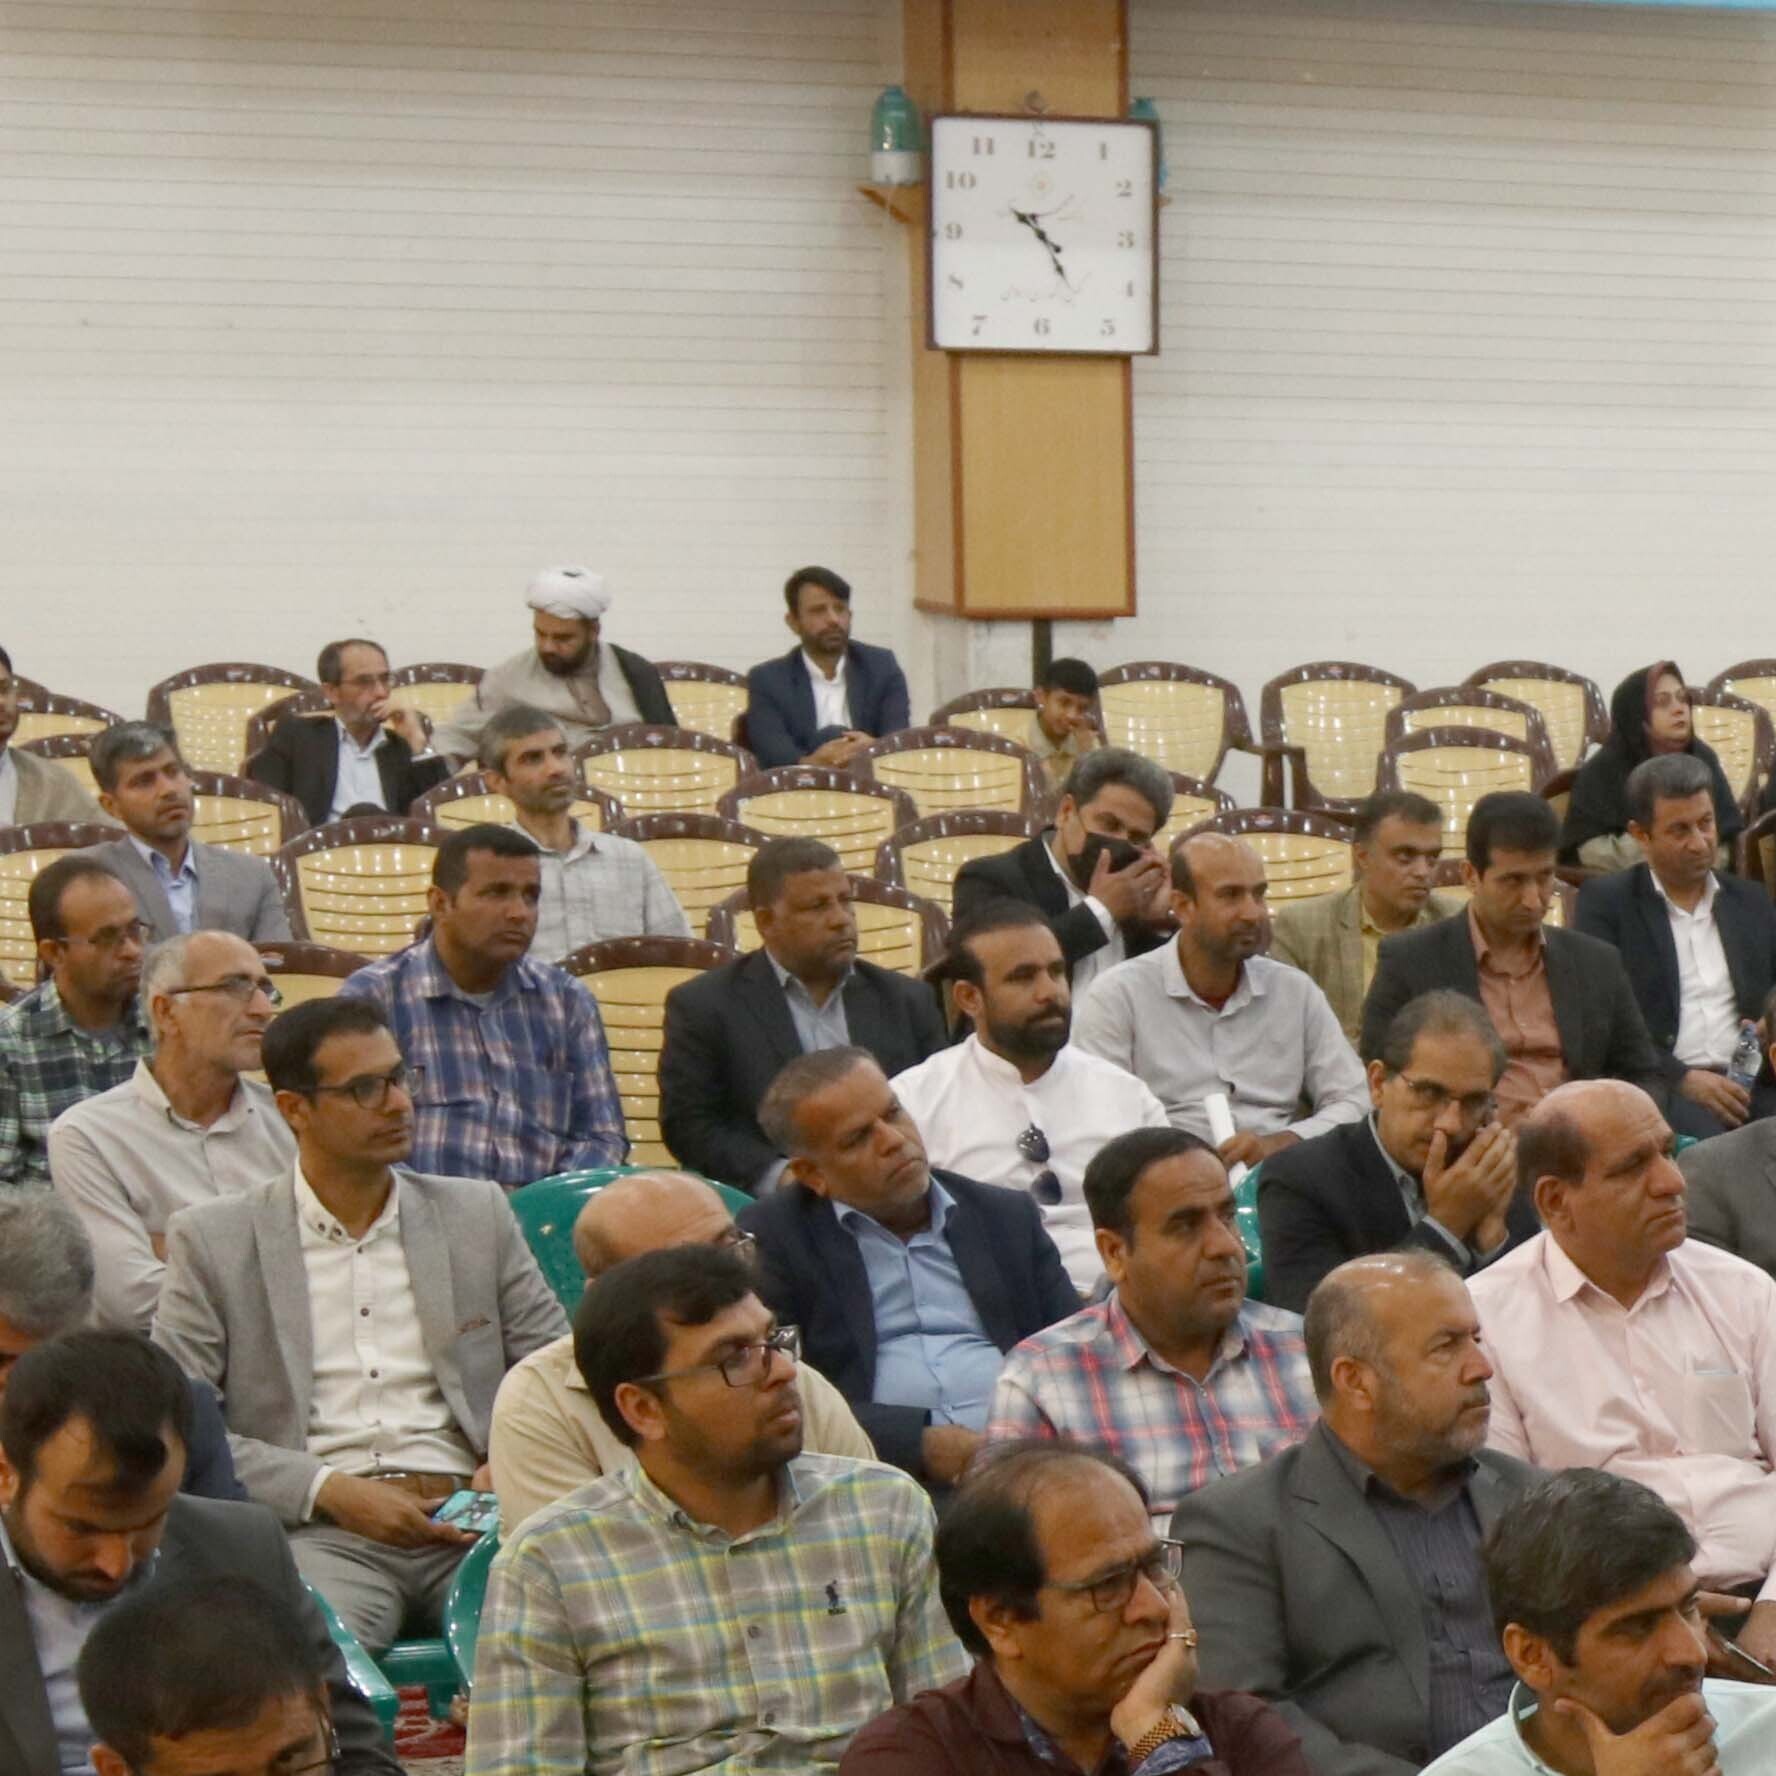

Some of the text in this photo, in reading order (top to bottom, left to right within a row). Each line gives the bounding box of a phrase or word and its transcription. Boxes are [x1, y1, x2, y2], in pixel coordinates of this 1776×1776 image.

[972, 137, 995, 156] 11
[1027, 140, 1056, 160] 12
[1099, 142, 1108, 160] 1
[945, 170, 976, 190] 10
[1116, 179, 1132, 198] 2
[945, 223, 963, 240] 9
[1117, 231, 1134, 249] 3
[971, 314, 988, 336] 7
[1033, 318, 1050, 336] 6
[1100, 319, 1116, 336] 5
